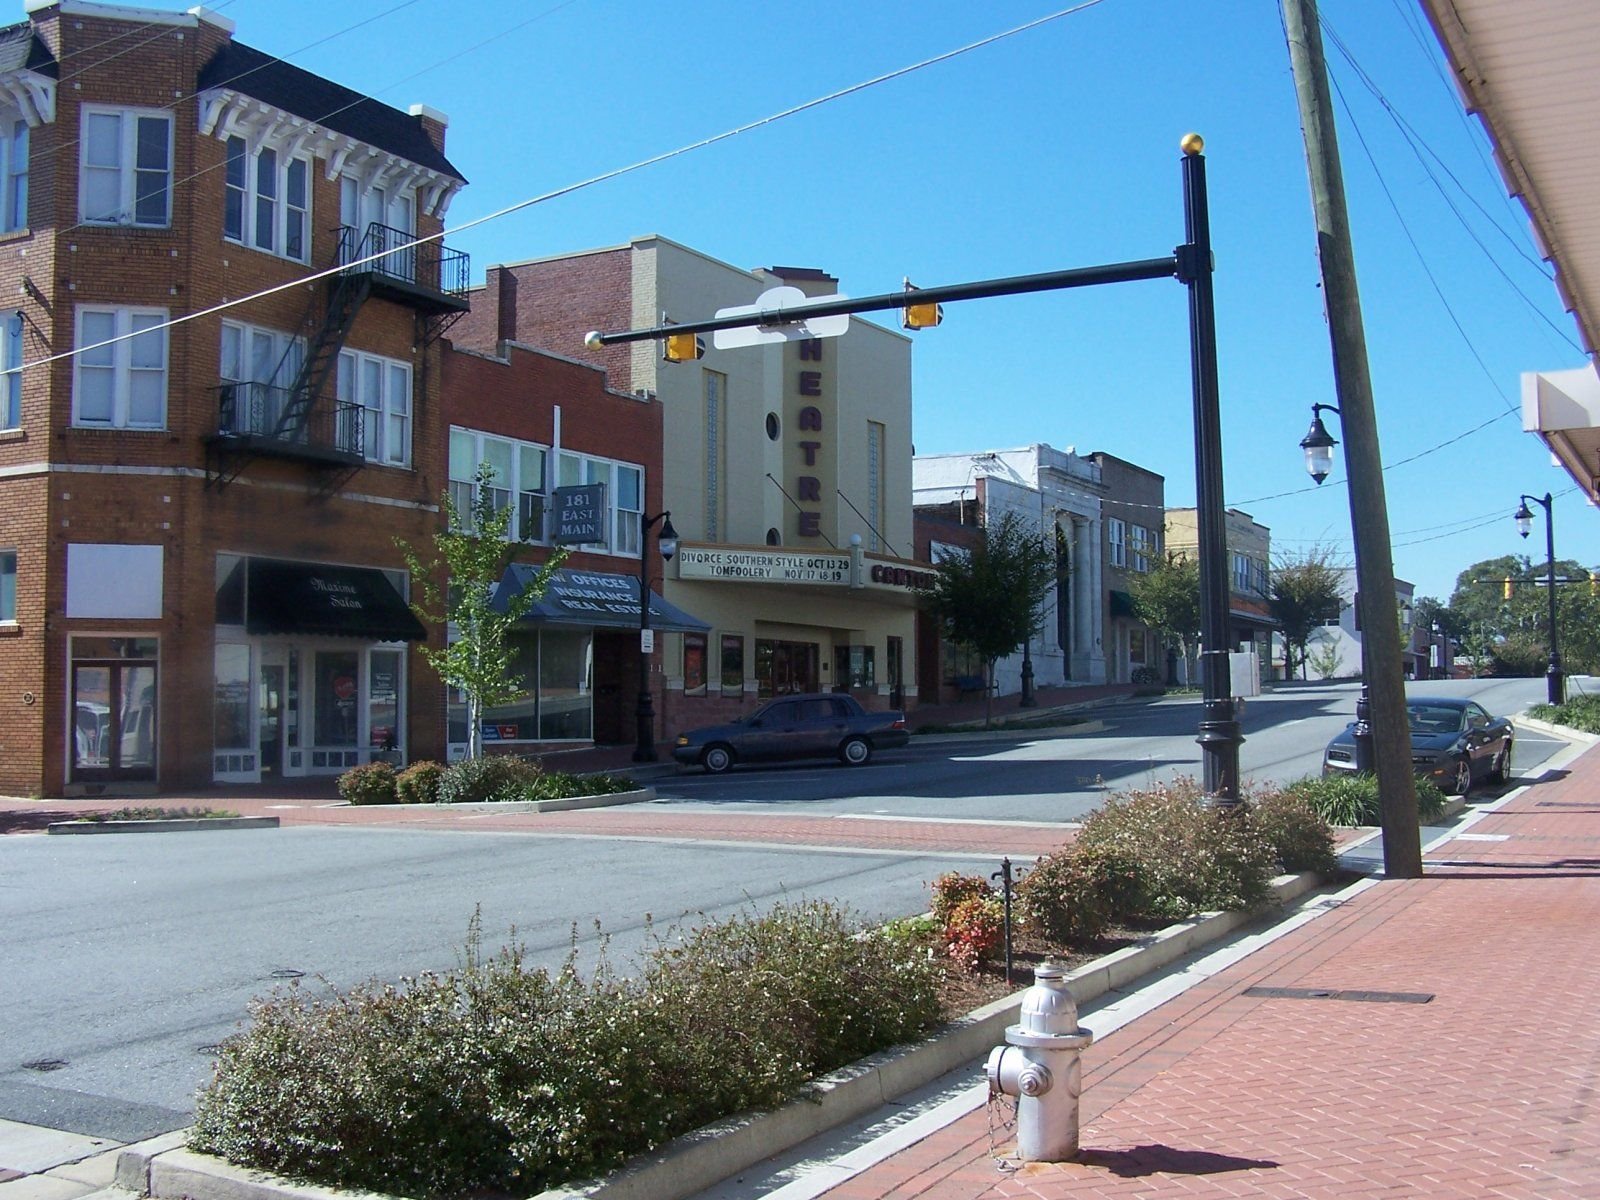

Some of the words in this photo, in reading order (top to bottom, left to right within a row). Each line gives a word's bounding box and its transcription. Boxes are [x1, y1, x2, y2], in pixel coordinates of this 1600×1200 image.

[798, 336, 822, 537] HEATRE
[565, 494, 590, 507] 181
[562, 509, 593, 521] EAST
[561, 523, 595, 536] MAIN
[681, 552, 722, 564] DIVORCE
[727, 554, 773, 566] SOUTHERN
[775, 557, 804, 568] STYLE
[807, 559, 824, 569] OCT
[827, 560, 835, 569] 13
[838, 560, 849, 569] 29
[710, 566, 771, 577] TOMFOOLERY
[785, 569, 802, 579] NOV
[807, 570, 815, 579] 17
[832, 571, 842, 580] 19
[571, 574, 631, 590] OFFICES
[330, 594, 362, 609] Salon
[553, 586, 639, 603] INSURANCE
[561, 599, 607, 612] REAL
